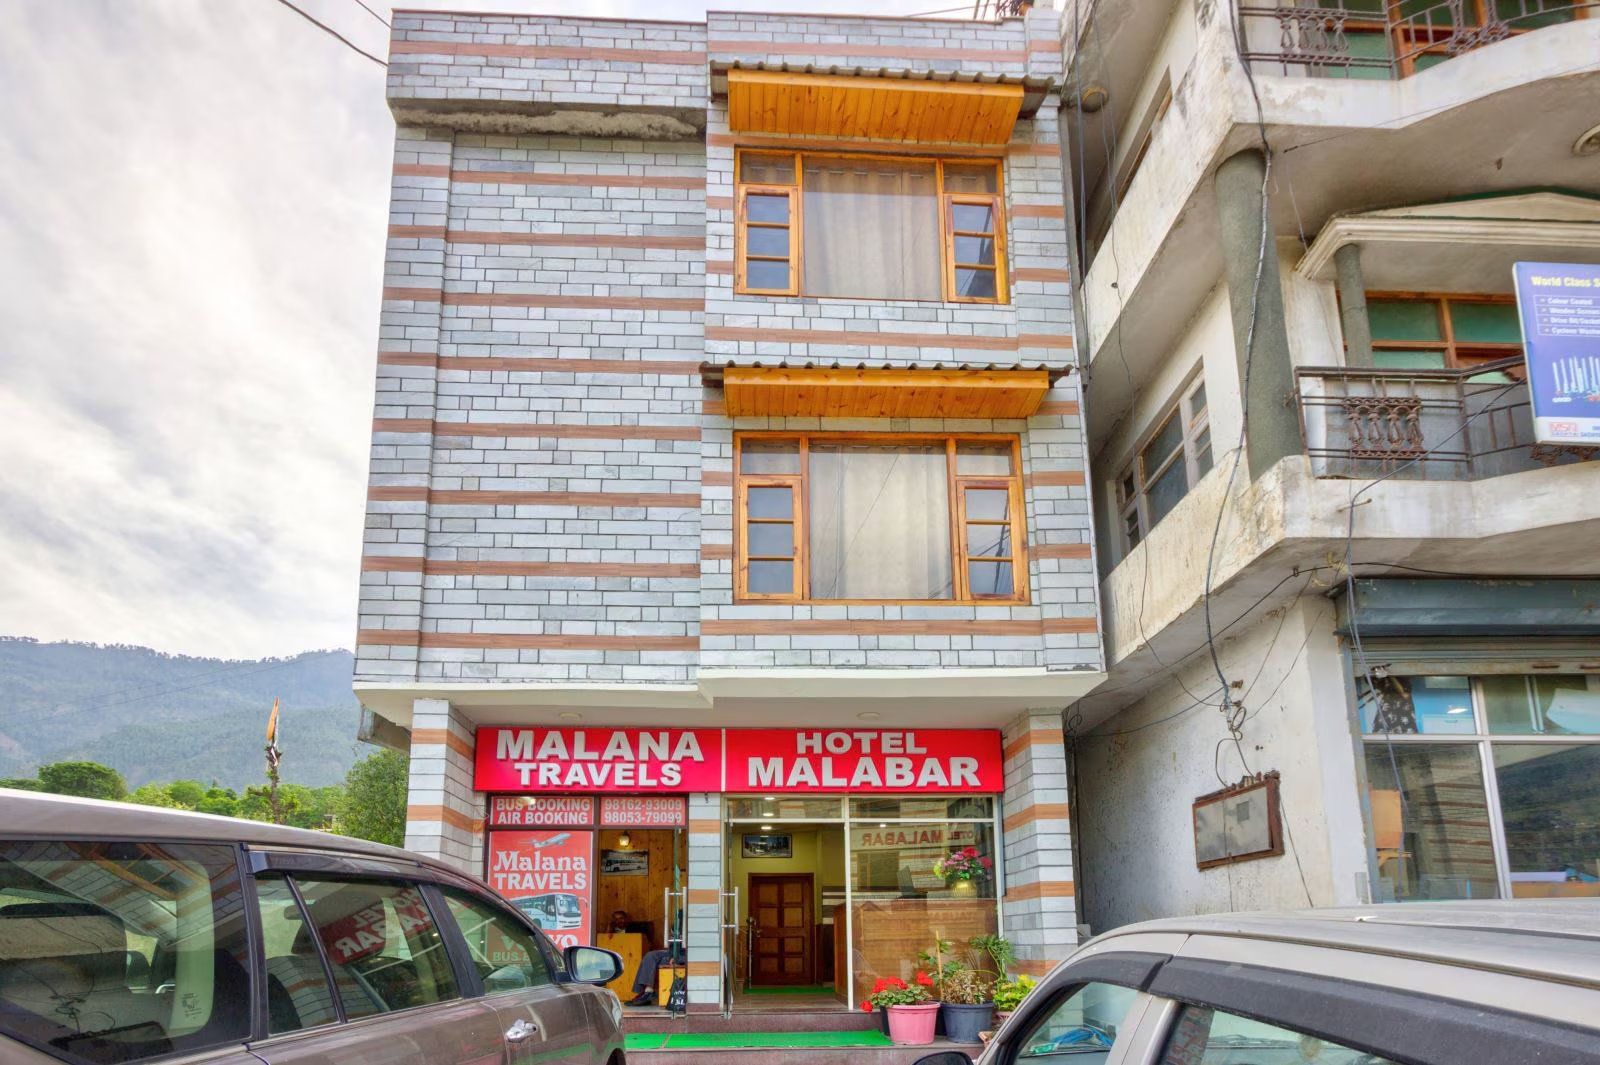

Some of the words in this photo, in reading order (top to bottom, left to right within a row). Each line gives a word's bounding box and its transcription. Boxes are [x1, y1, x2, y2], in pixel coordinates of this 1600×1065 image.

[1531, 276, 1561, 287] World
[1564, 277, 1591, 288] Class
[496, 730, 704, 762] MALANA
[796, 732, 927, 755] HOTEL
[514, 763, 682, 787] TRAVELS
[748, 756, 982, 788] MALABAR
[496, 799, 523, 811] BUS
[525, 799, 590, 811] BOOKING
[497, 812, 521, 824] AIR
[525, 812, 588, 825] BOOKING
[493, 851, 586, 871] Malana
[494, 873, 586, 890] TRAVELS
